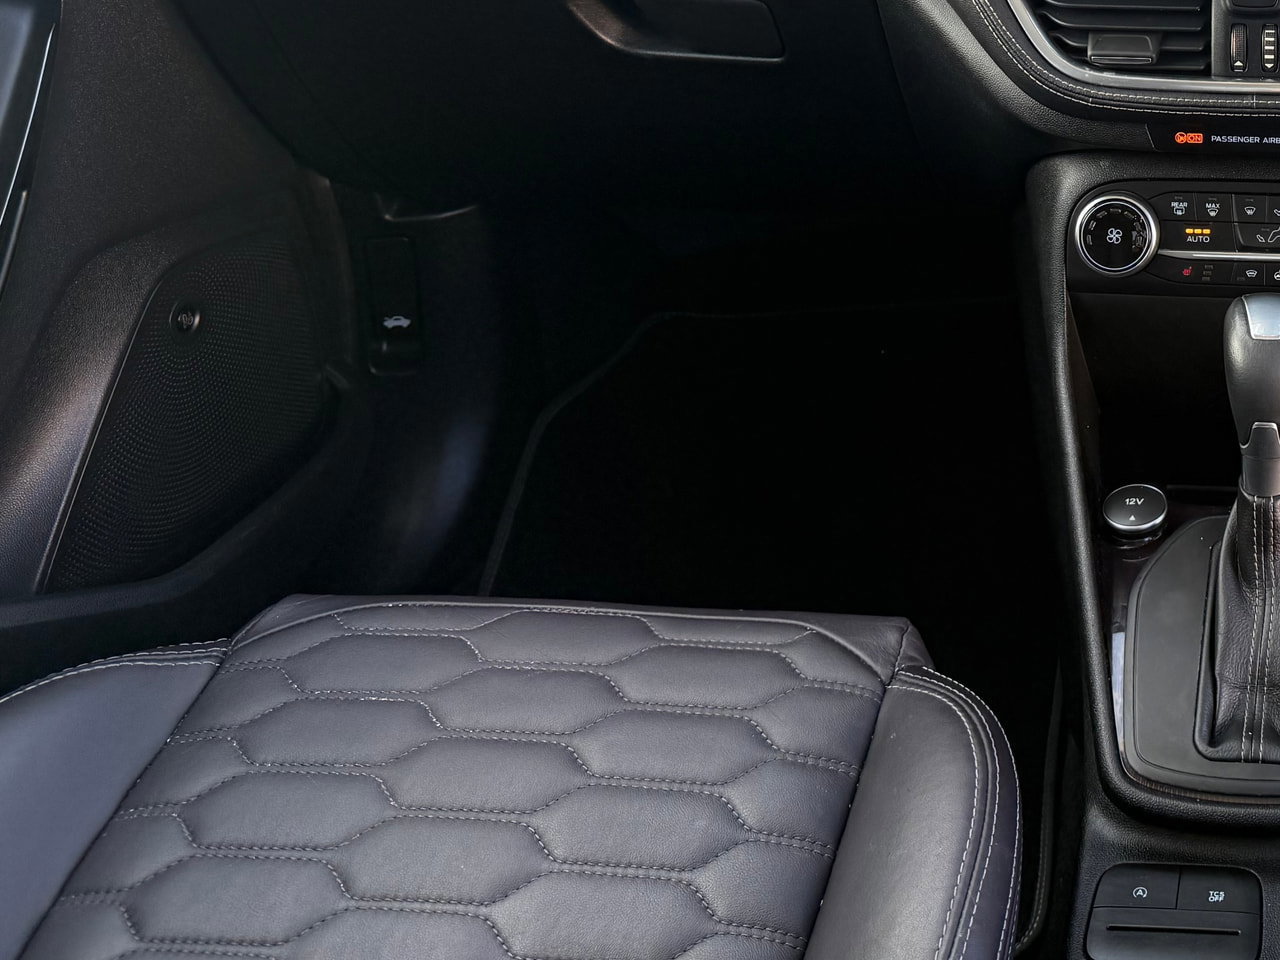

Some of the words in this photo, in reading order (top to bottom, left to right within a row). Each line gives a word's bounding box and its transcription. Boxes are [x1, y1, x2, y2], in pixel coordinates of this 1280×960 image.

[1211, 135, 1260, 143] PASSENGER
[1186, 235, 1210, 243] AUTO
[1125, 497, 1144, 506] 12V
